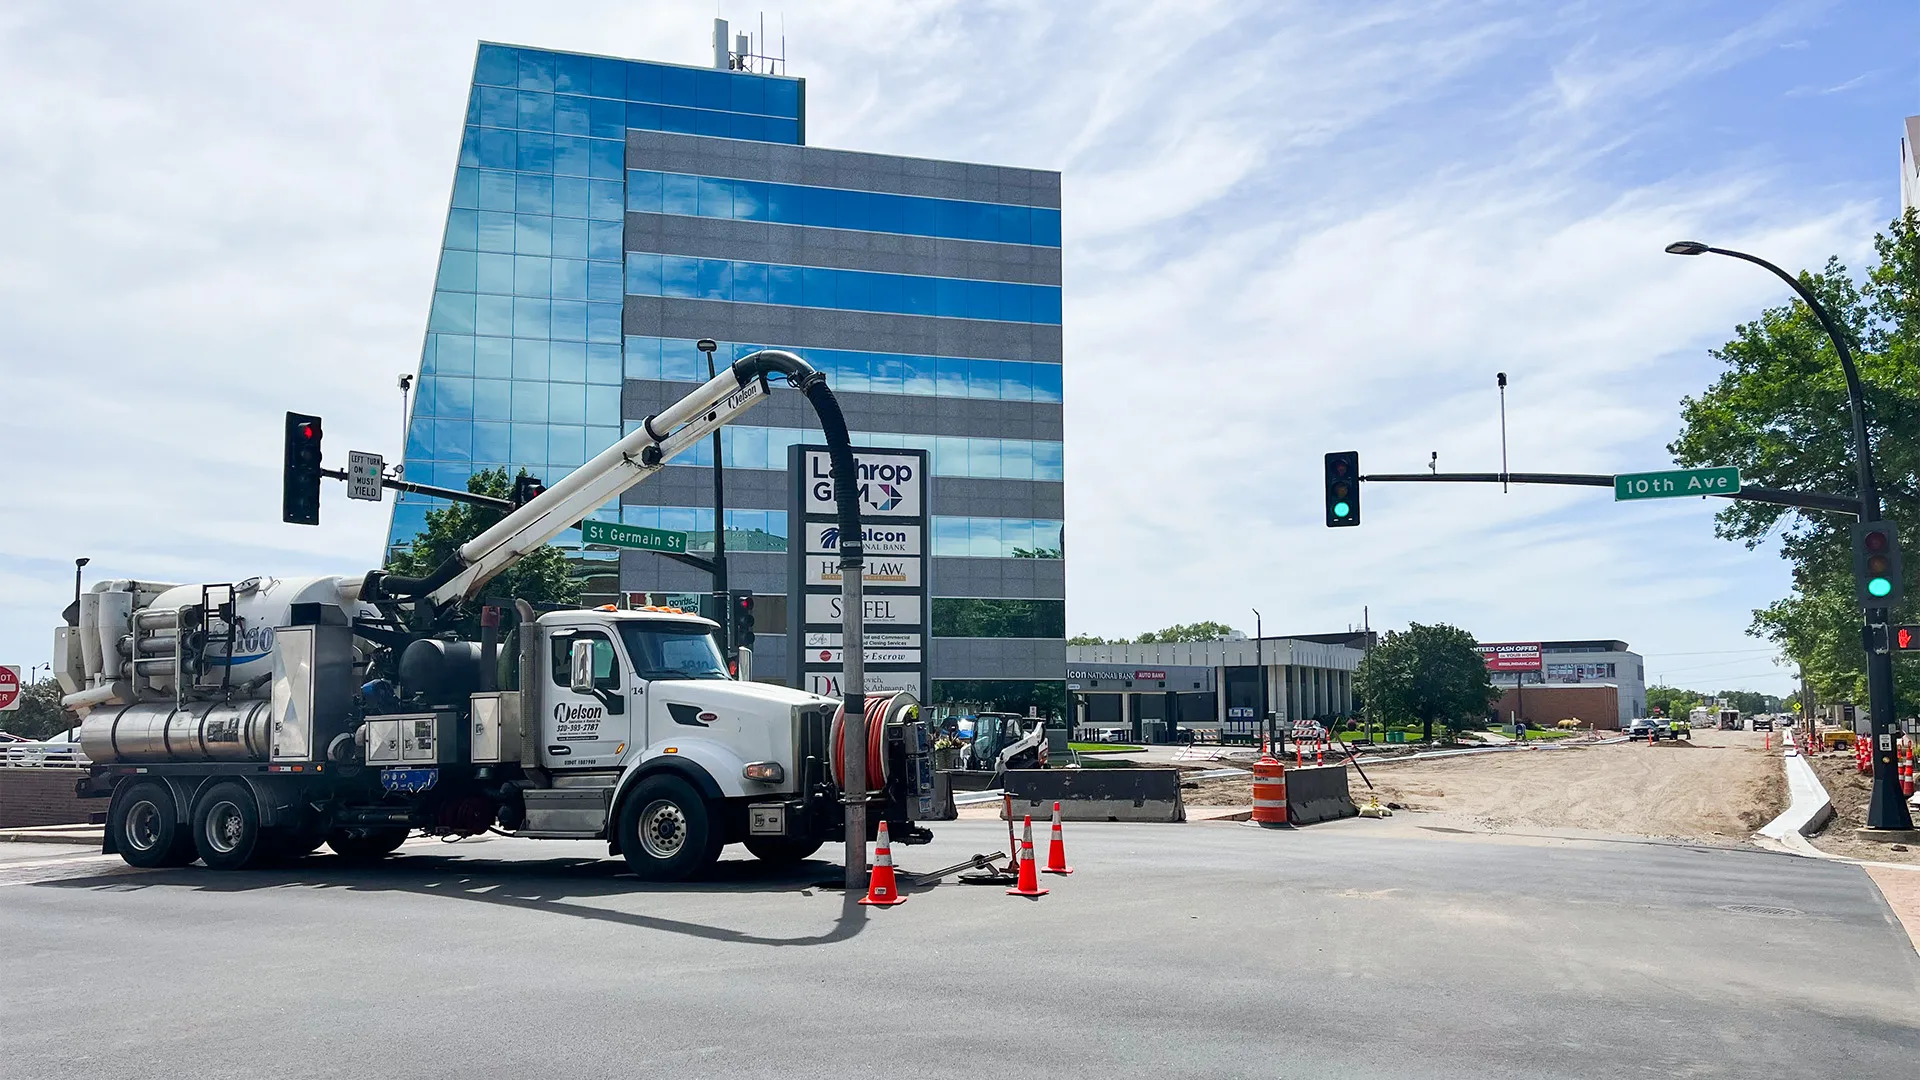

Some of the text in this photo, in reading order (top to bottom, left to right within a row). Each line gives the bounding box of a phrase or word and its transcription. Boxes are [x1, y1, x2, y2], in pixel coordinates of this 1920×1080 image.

[728, 384, 757, 409] Nelson
[351, 455, 380, 465] LEFT TURN
[813, 456, 912, 485] Lhrop
[357, 477, 374, 485] MUST
[1626, 476, 1727, 494] 10th Ave
[354, 486, 376, 497] YIELD
[813, 482, 869, 503] GM
[590, 526, 680, 548] St Germain St
[861, 528, 906, 542] alcon
[870, 562, 903, 575] LAW
[830, 597, 895, 618] SFEL
[871, 652, 906, 660] Escrow
[0, 674, 12, 682] OT
[1087, 671, 1117, 680] NATIONAL
[1118, 672, 1135, 680] BANK
[907, 684, 917, 692] PA
[554, 702, 602, 723] Nelson
